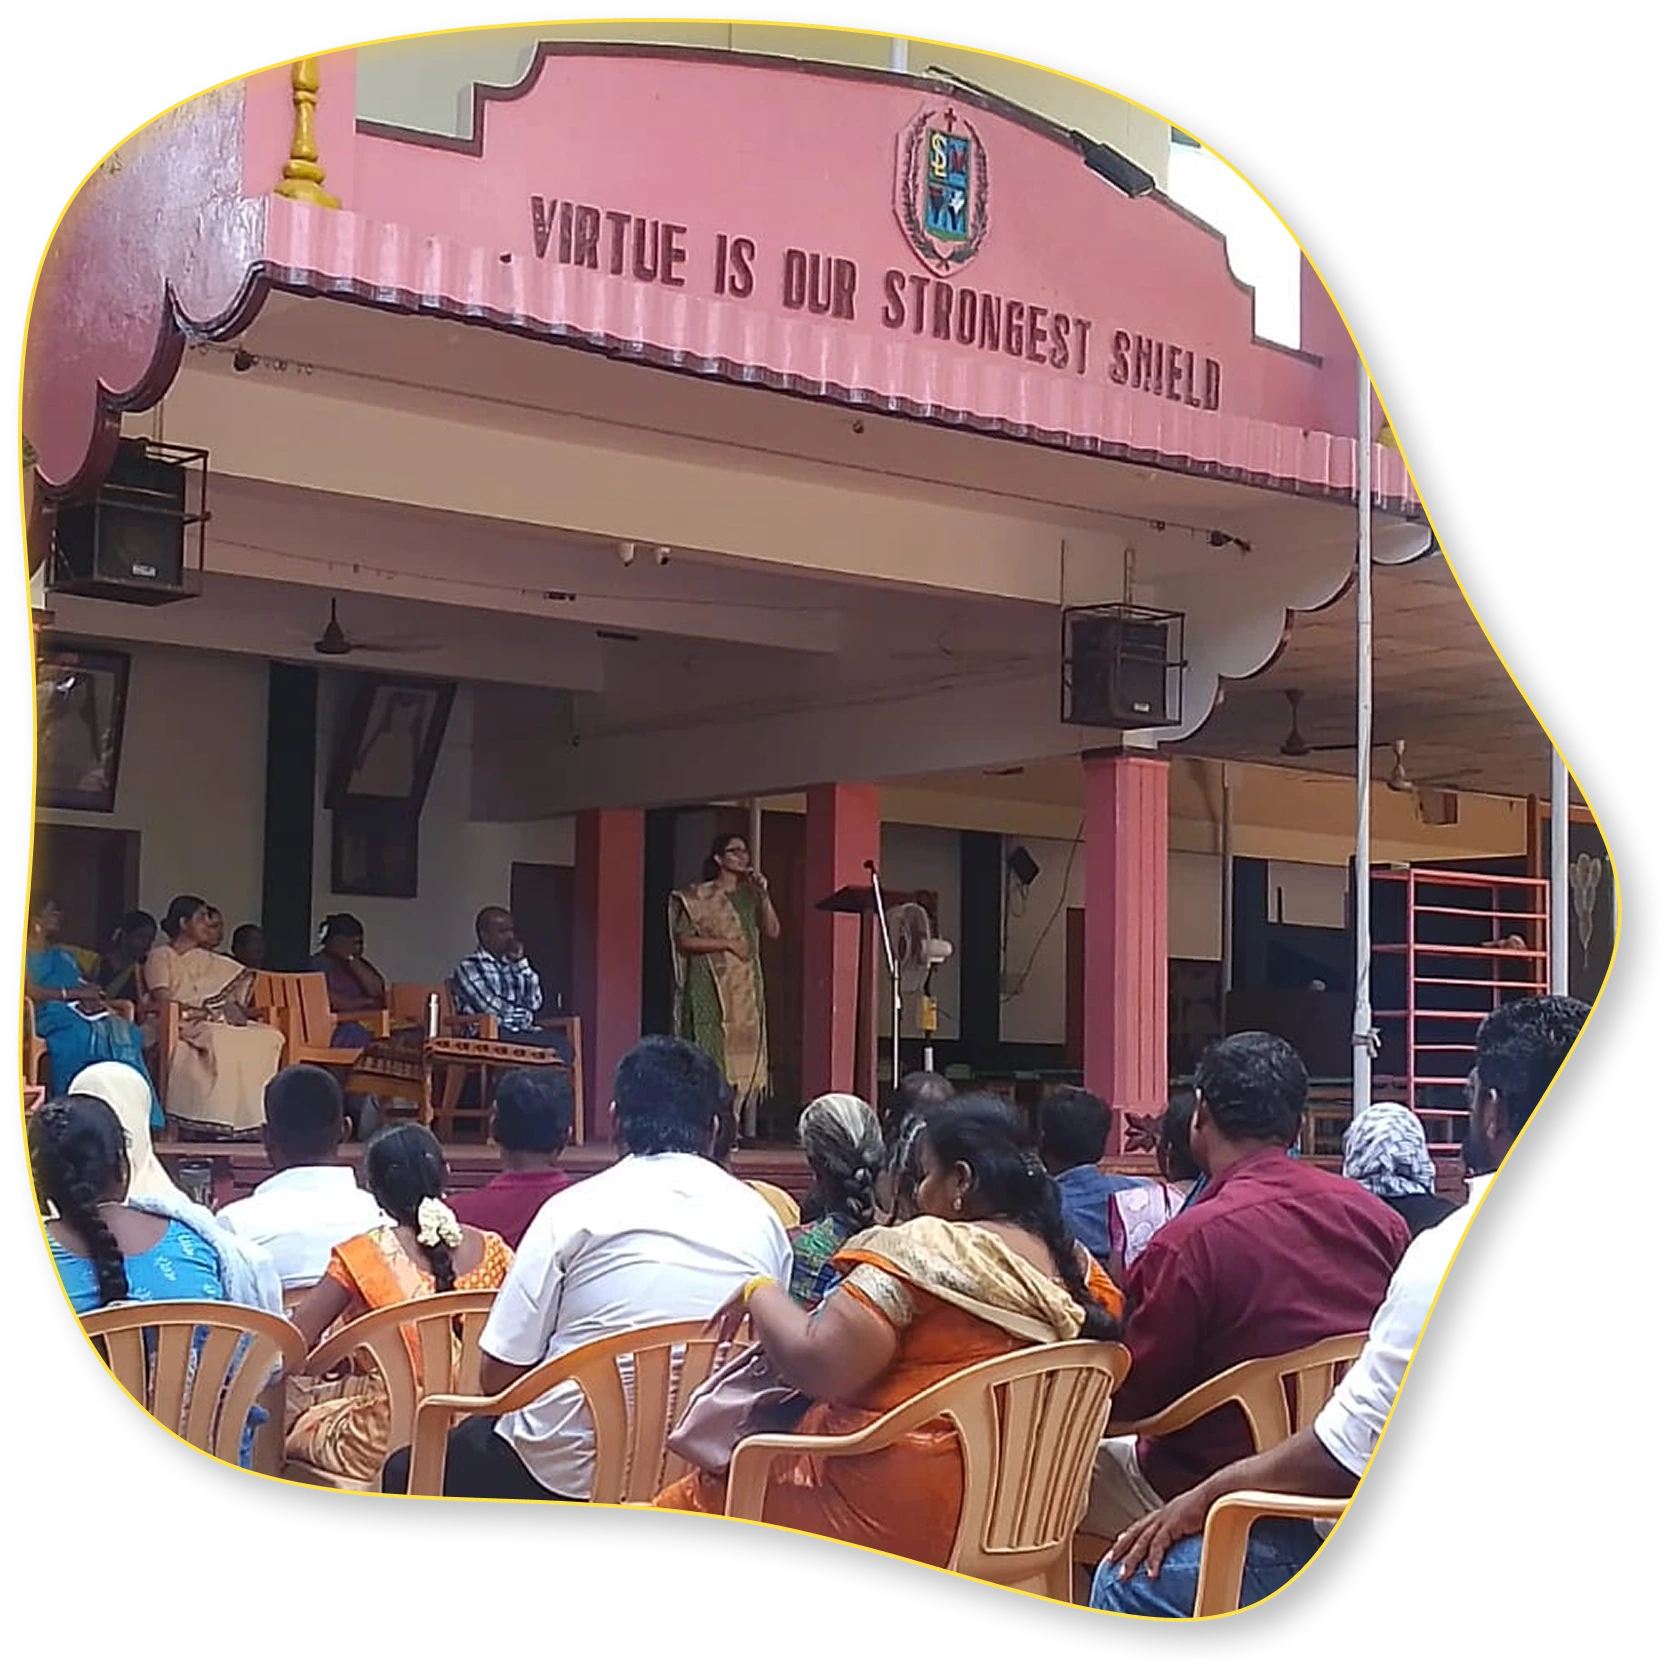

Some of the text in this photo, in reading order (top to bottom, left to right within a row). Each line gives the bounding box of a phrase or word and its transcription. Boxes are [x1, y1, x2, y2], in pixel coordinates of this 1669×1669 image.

[530, 195, 1221, 412] VIRTUE IS OUR STRONGEST SHIELD
